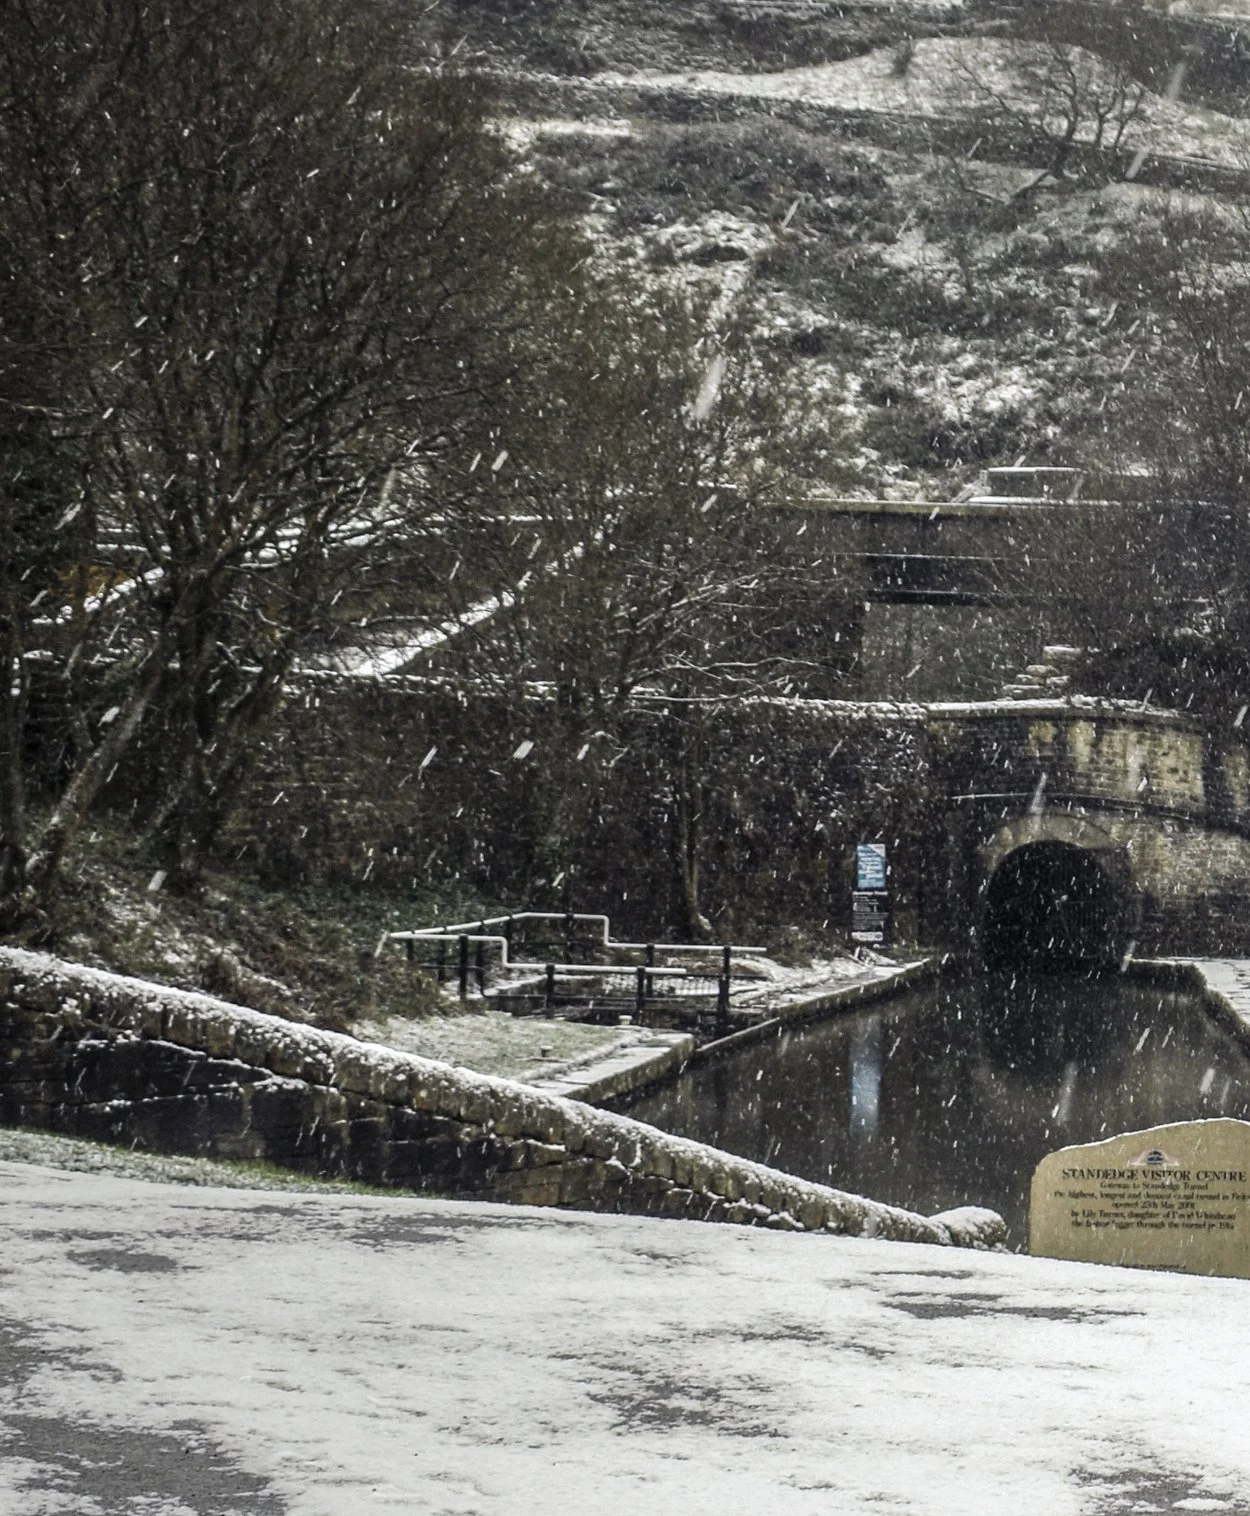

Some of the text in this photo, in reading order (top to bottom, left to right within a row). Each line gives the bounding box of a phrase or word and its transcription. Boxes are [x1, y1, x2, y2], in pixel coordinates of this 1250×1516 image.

[1062, 1168, 1247, 1183] STANDEDGE VISITOR CENTRE
[1183, 1182, 1208, 1191] Tunnel
[1127, 1191, 1141, 1199] and
